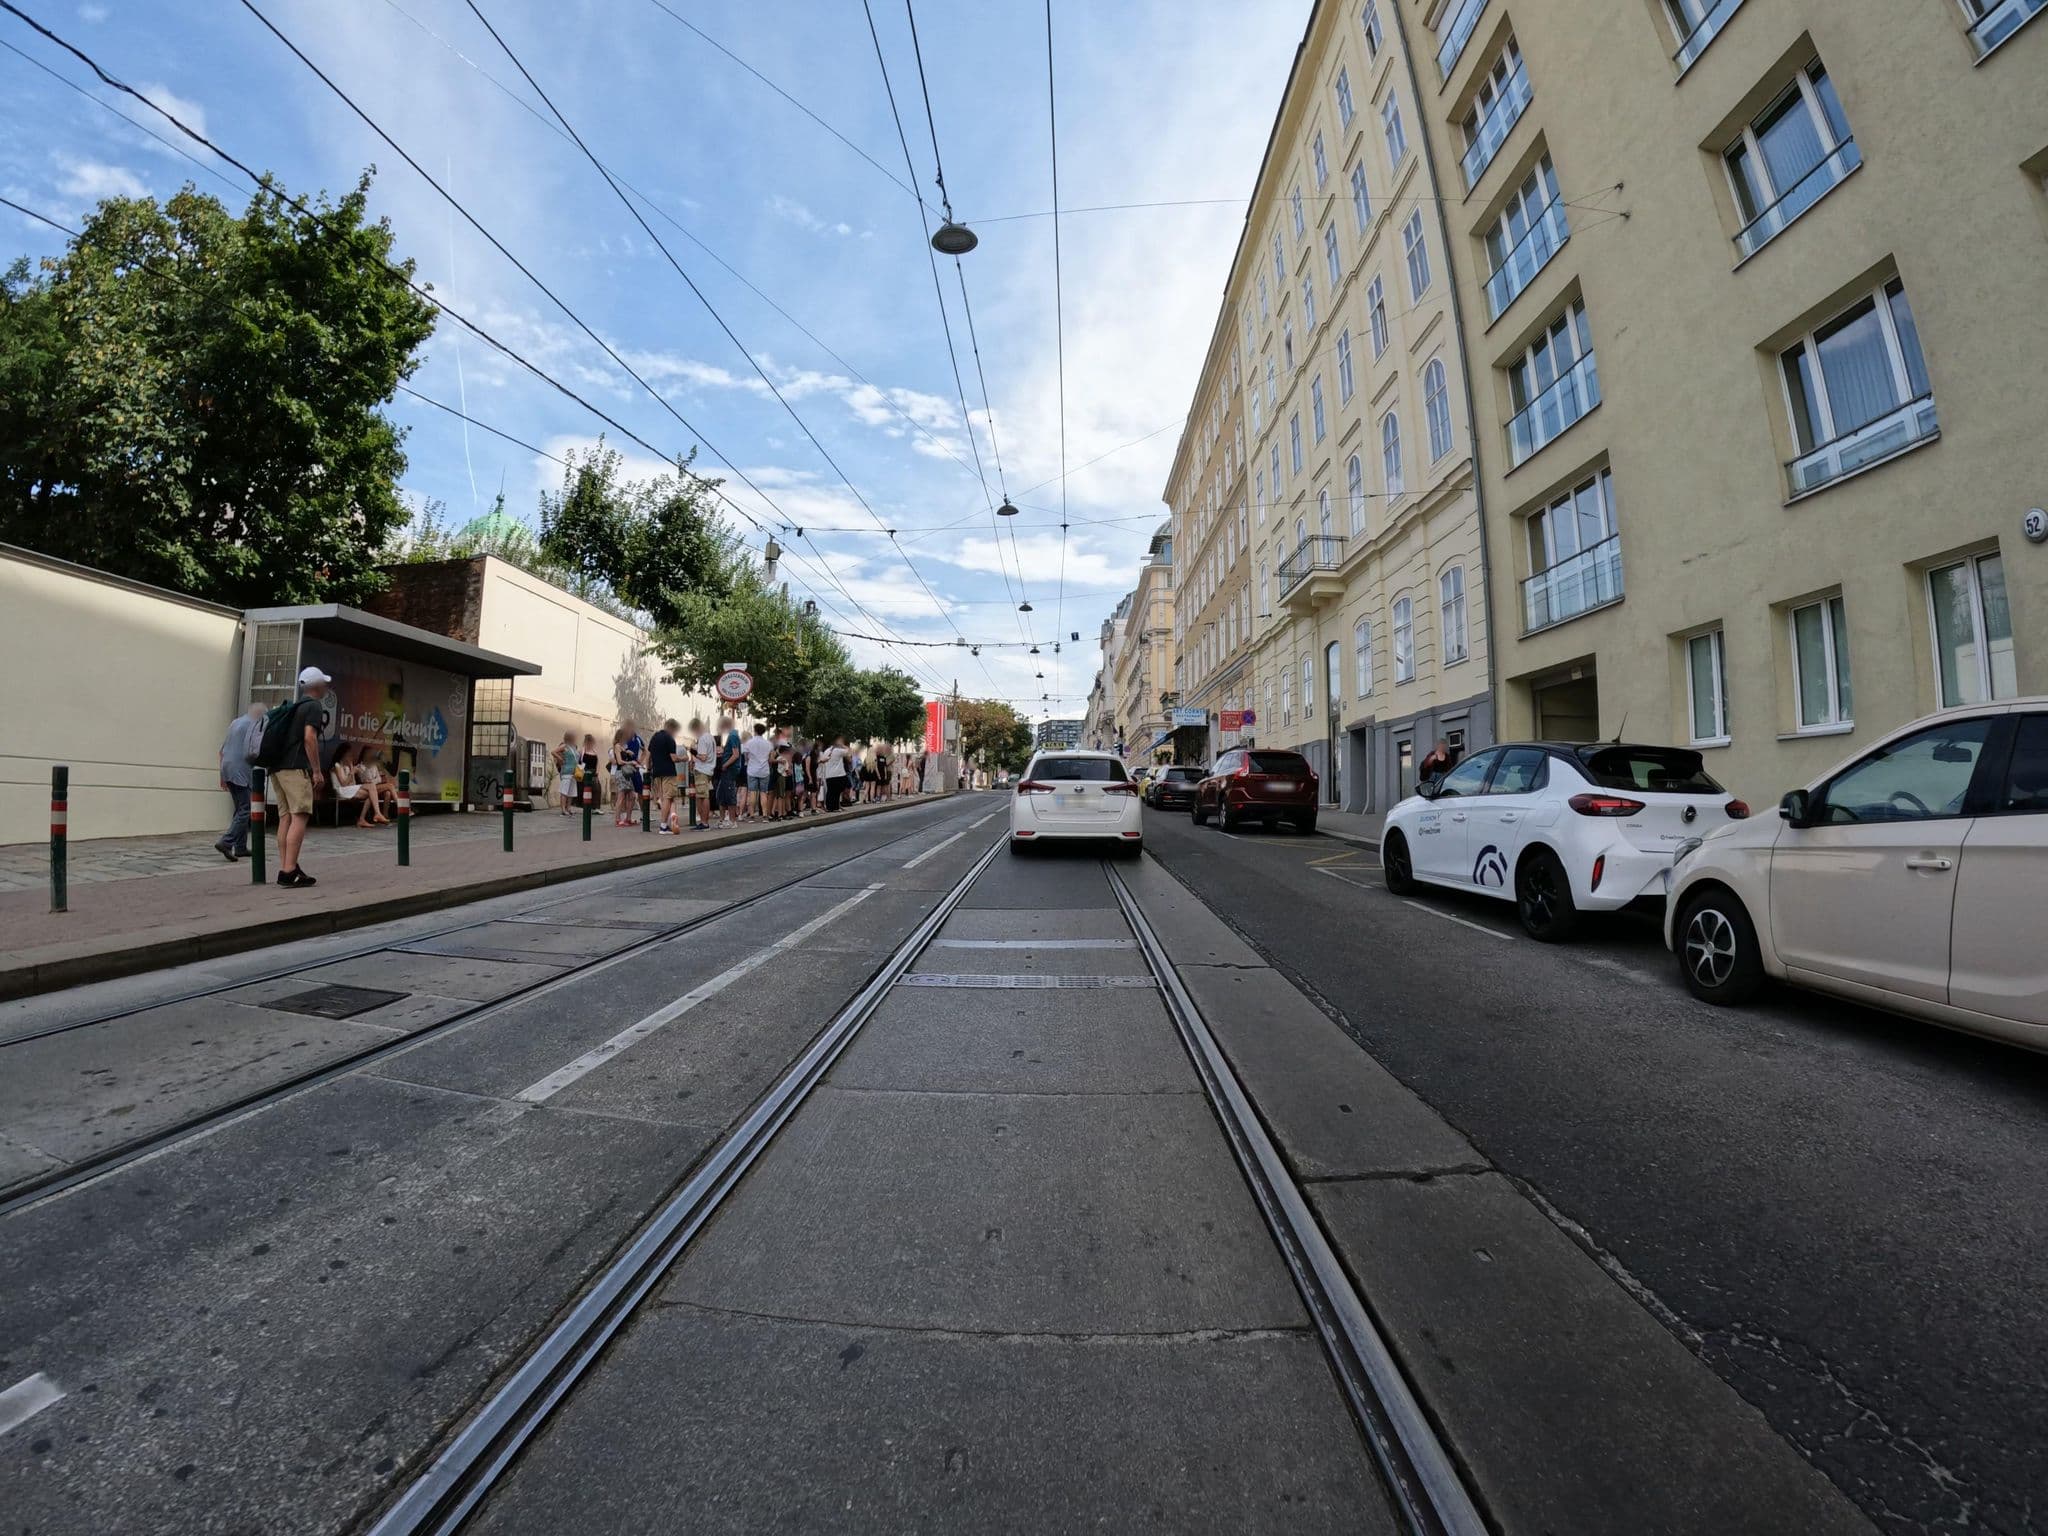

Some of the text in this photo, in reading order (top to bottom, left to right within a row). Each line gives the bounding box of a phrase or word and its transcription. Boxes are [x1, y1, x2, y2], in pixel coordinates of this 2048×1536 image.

[2026, 516, 2041, 535] 52
[340, 707, 354, 729] in
[357, 711, 380, 732] die
[382, 711, 443, 742] Zukunft.
